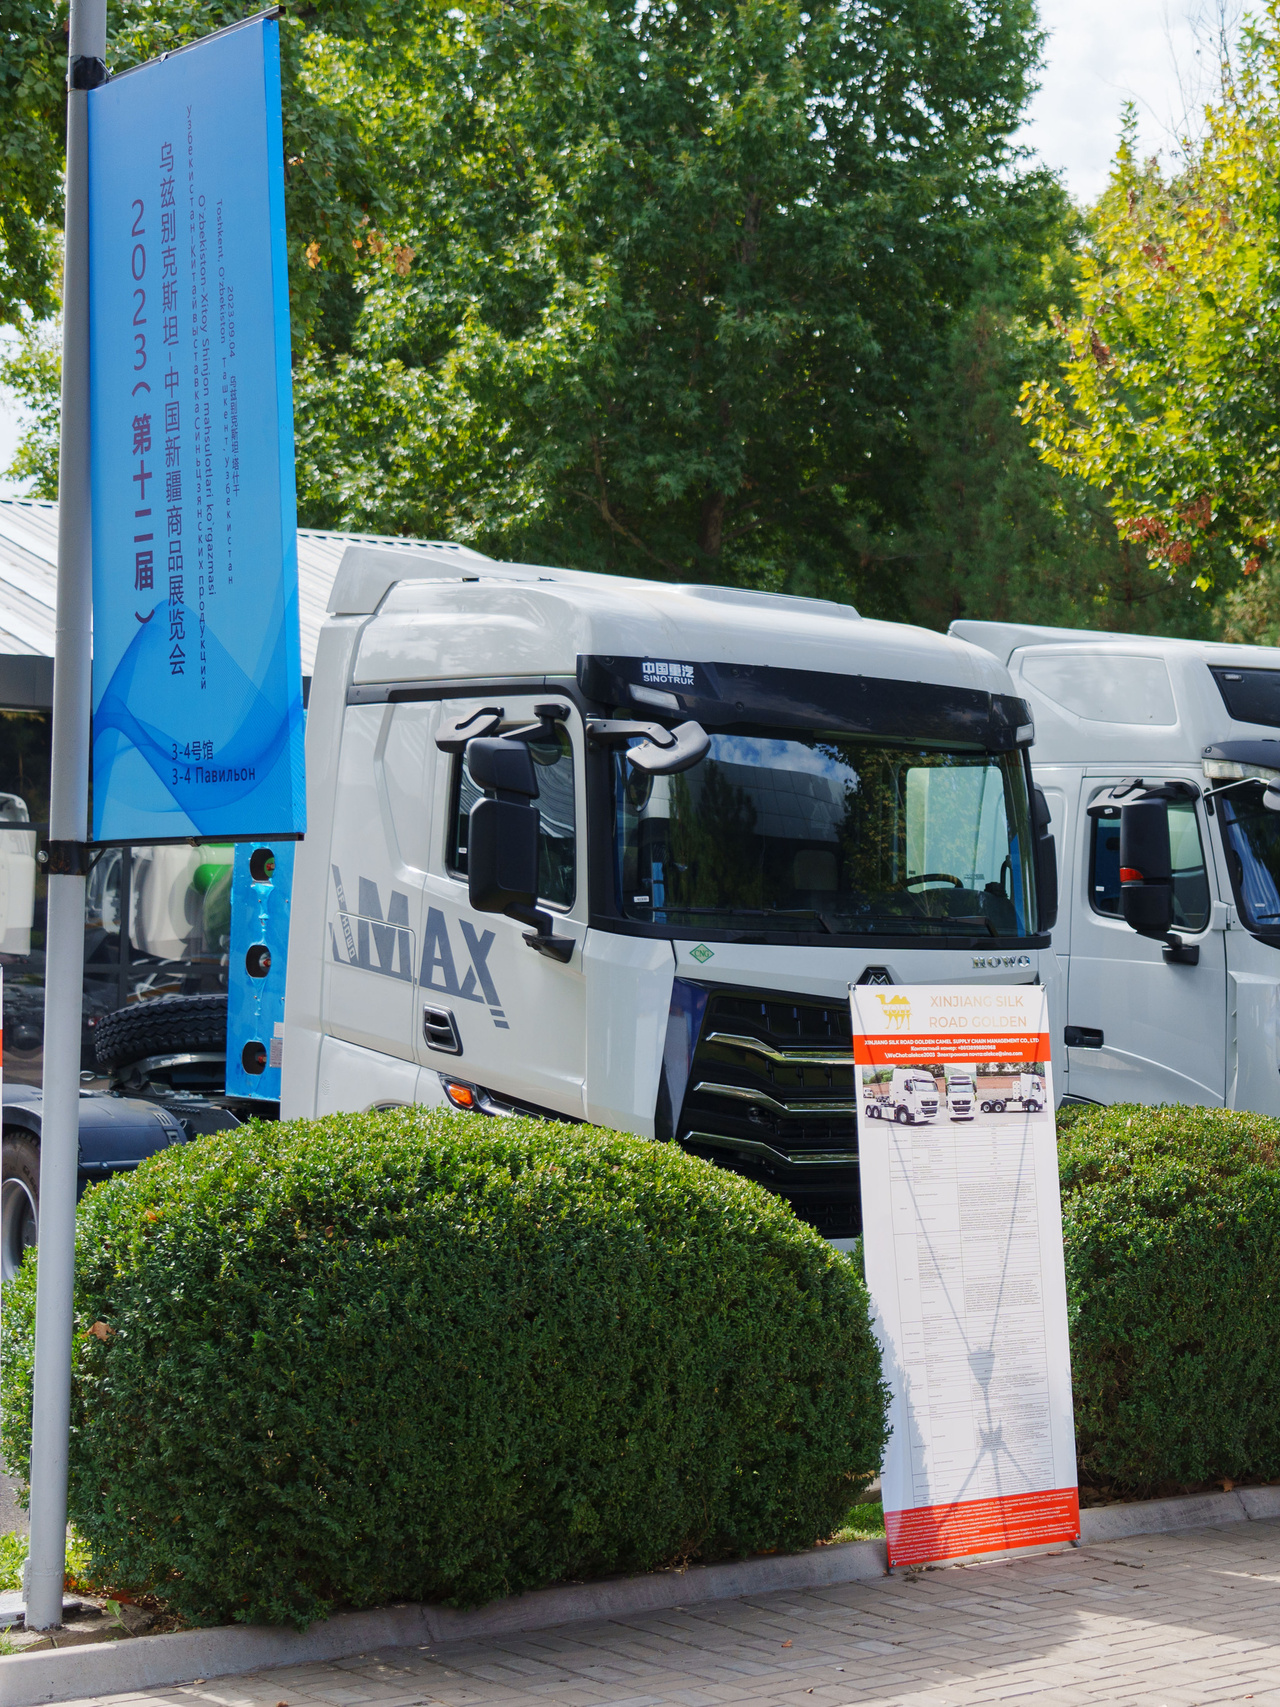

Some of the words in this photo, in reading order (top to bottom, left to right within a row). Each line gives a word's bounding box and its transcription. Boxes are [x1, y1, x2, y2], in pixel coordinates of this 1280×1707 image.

[227, 286, 236, 358] 2023.09.04
[201, 338, 211, 397] Shinjon
[203, 402, 214, 499] mahsulotlari
[642, 662, 695, 679] 中国重汽
[643, 675, 695, 686] SINOTRUK
[172, 740, 214, 761] 3-4号馆
[172, 768, 192, 785] 3-4
[195, 767, 256, 784] Павильон
[342, 916, 356, 959] HOWO
[357, 875, 502, 1007] MAX
[694, 949, 710, 958] CNG
[971, 956, 1031, 969] HOWO
[930, 995, 993, 1008] XINJIANG
[996, 995, 1024, 1008] SILK
[929, 1016, 968, 1028] ROAD
[972, 1015, 1027, 1028] GOLDEN
